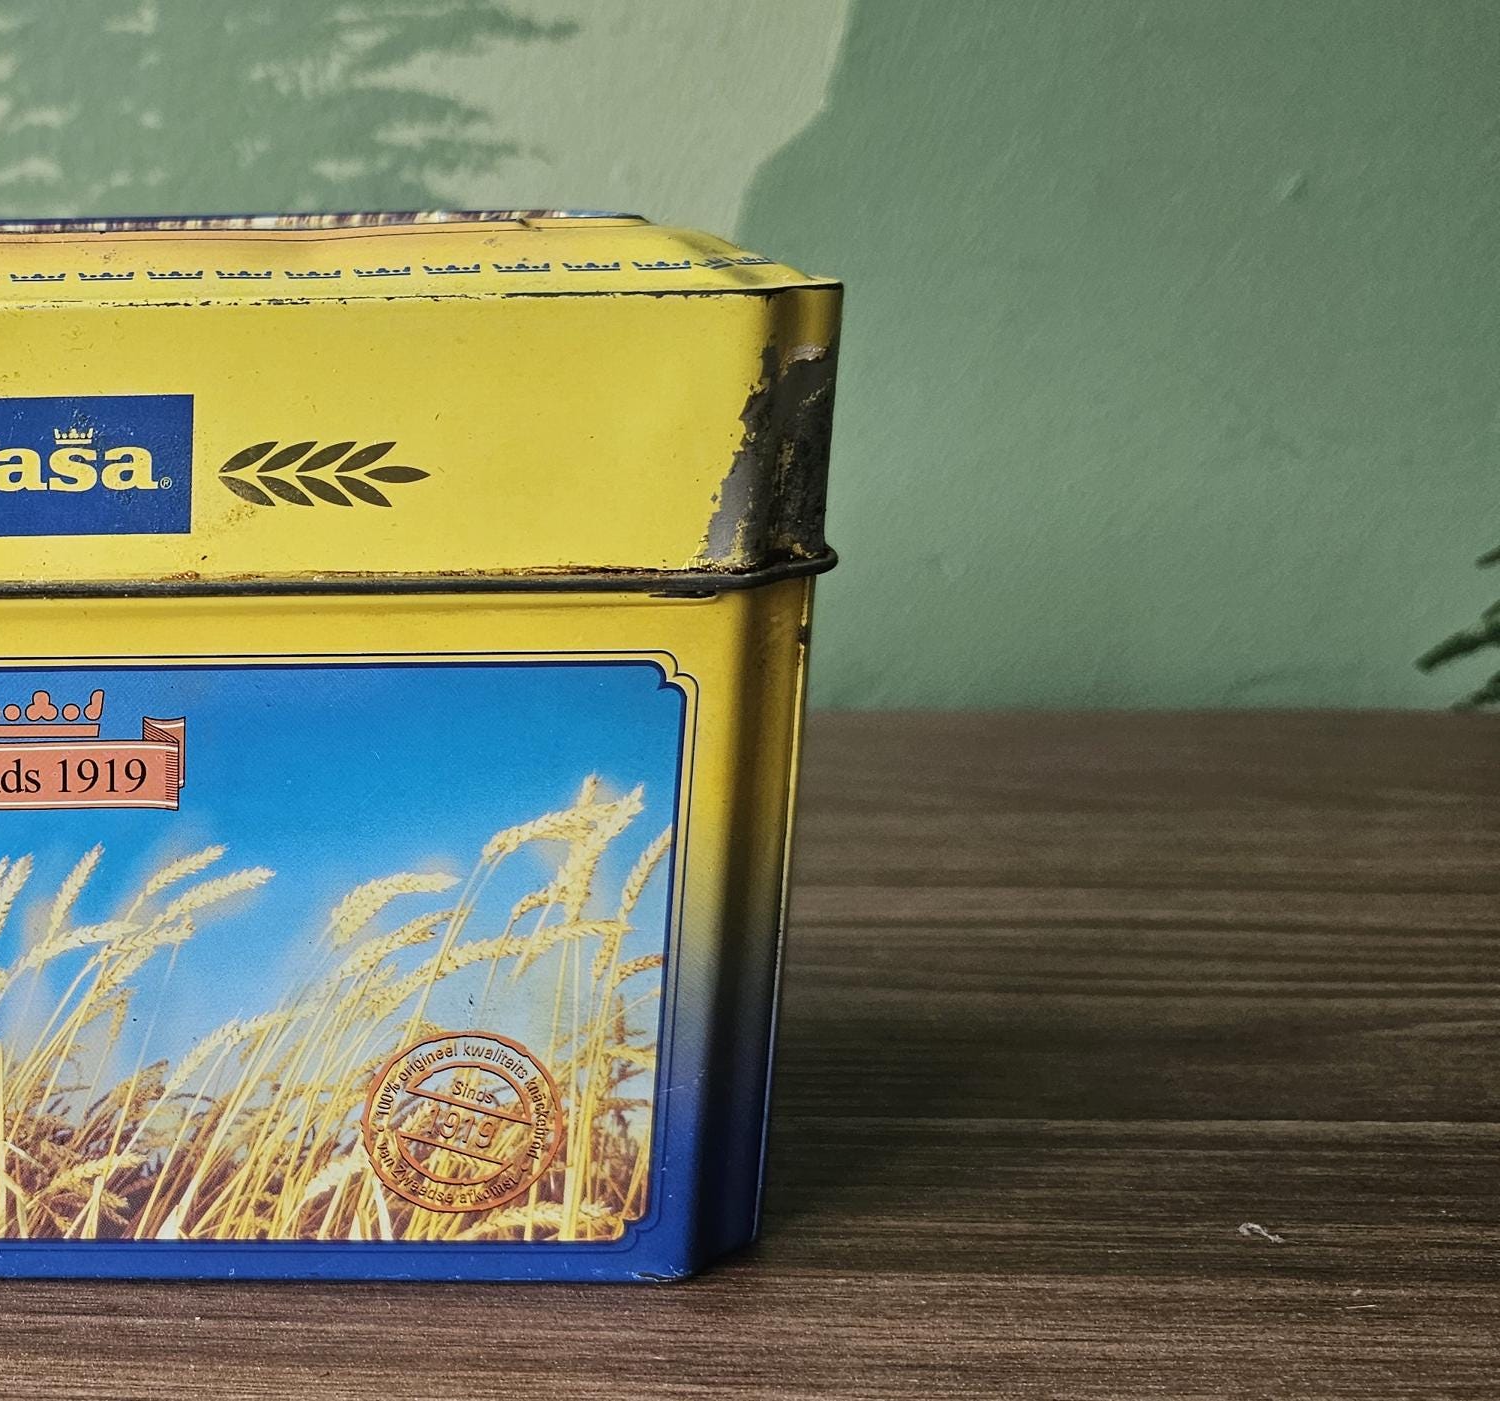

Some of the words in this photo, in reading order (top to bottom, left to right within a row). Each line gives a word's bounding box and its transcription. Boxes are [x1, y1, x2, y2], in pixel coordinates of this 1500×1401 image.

[57, 758, 148, 793] 1919
[374, 1081, 401, 1116] 100%
[398, 1041, 458, 1082] origineel
[463, 1041, 529, 1080] kwaliteits
[452, 1081, 495, 1105] Sinds
[426, 1107, 498, 1149] 1919
[377, 1141, 395, 1168] van
[391, 1163, 454, 1205] Zweedse
